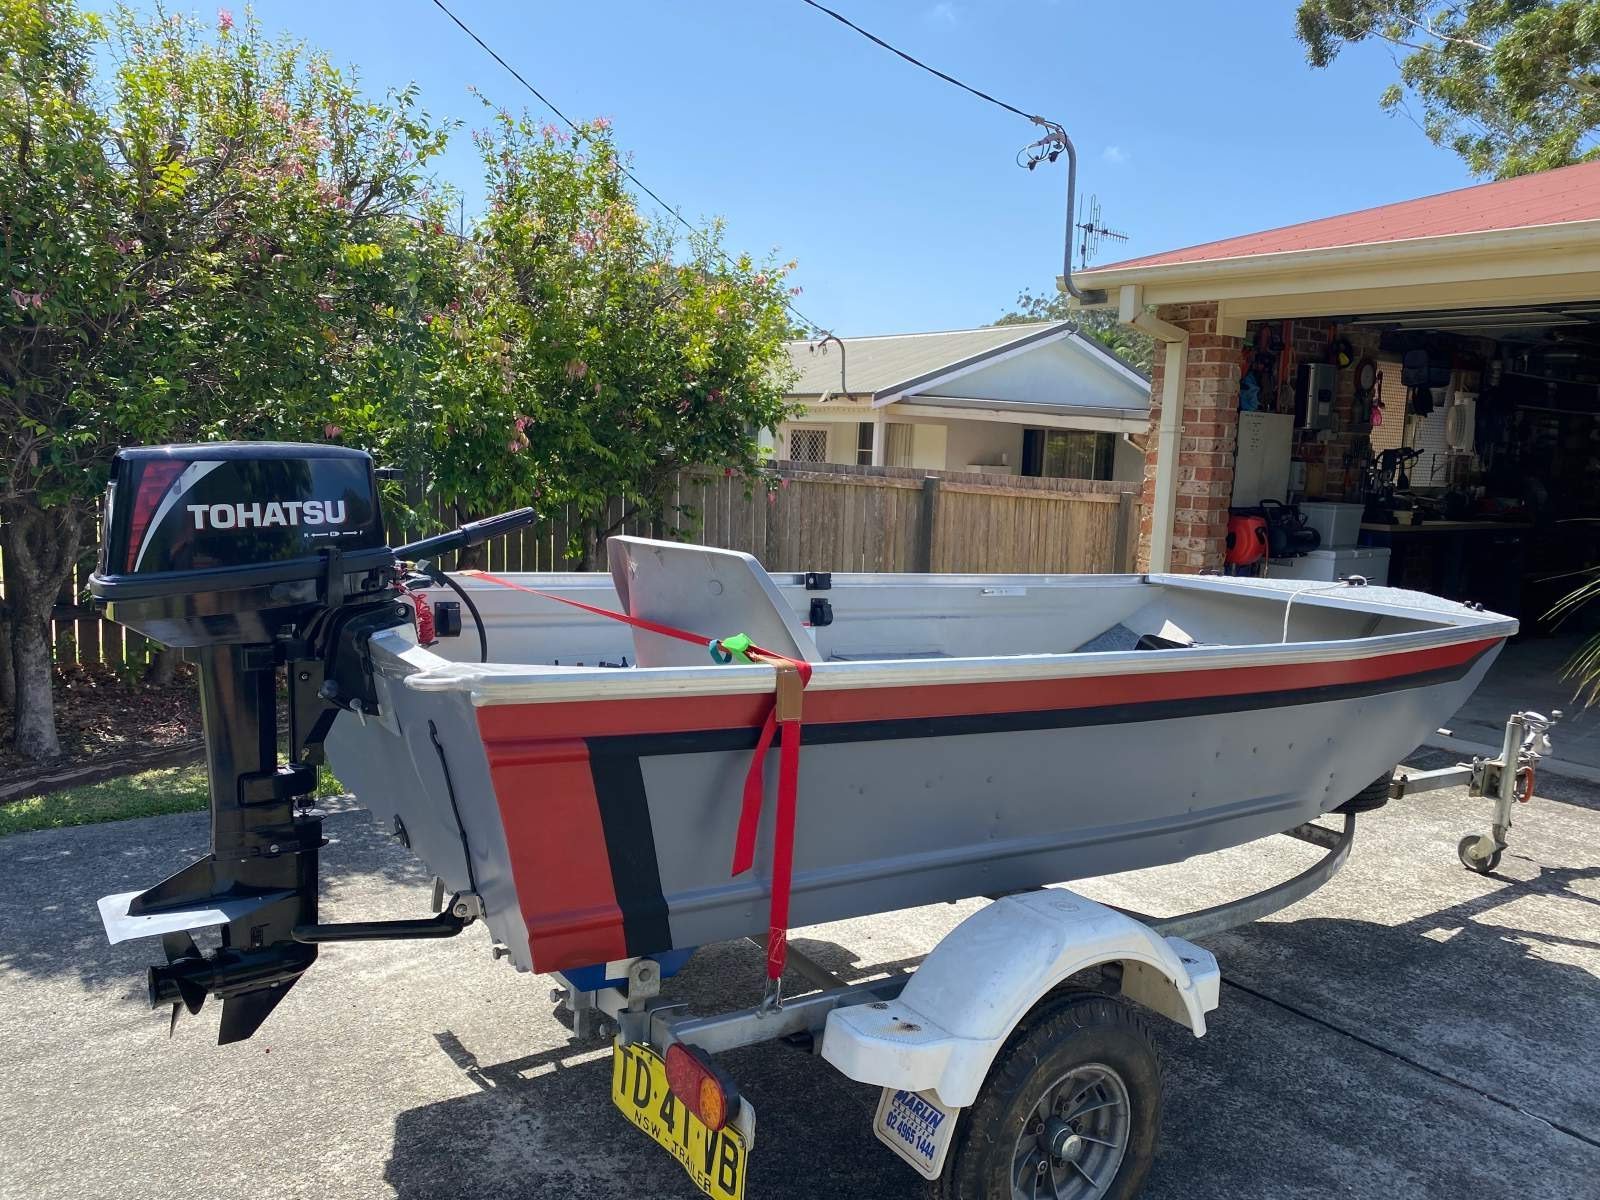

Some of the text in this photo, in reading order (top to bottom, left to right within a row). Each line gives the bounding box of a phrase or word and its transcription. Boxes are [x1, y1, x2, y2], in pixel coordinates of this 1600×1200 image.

[187, 500, 346, 529] TOHATSU
[894, 1090, 945, 1129] MARLIN
[634, 1110, 661, 1138] NSW
[671, 1141, 712, 1193] TRAILER
[886, 1111, 898, 1130] 02
[897, 1121, 916, 1144] 4965
[915, 1135, 936, 1161] 1444
